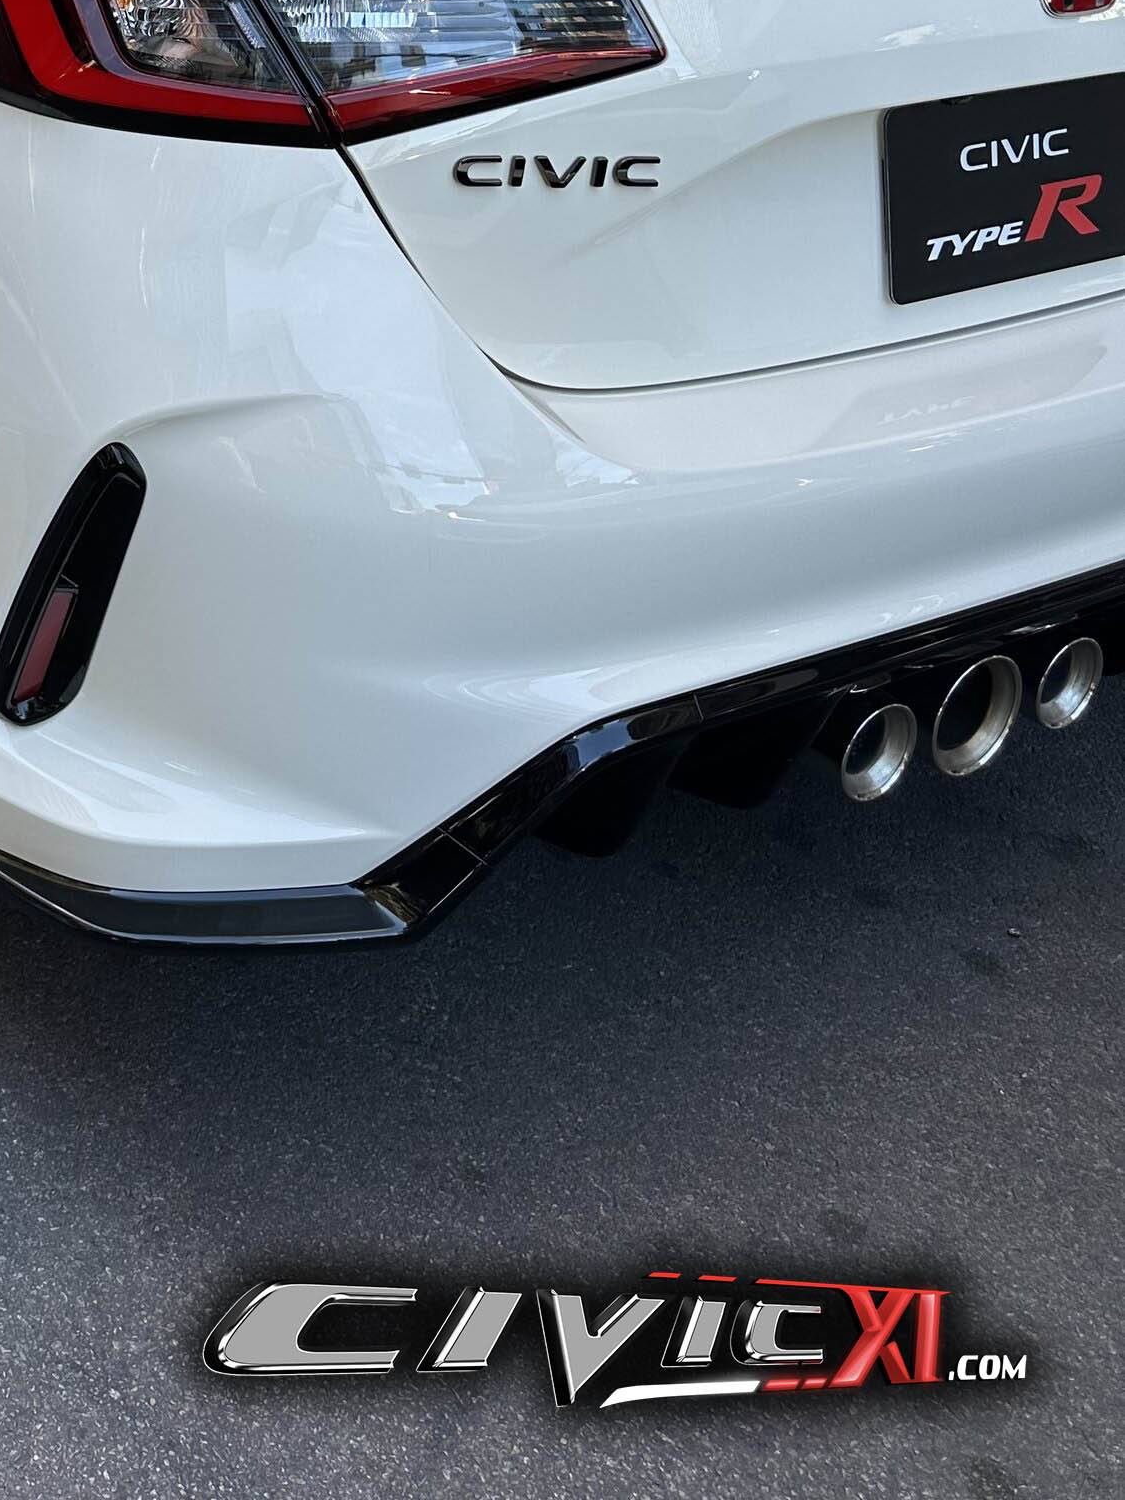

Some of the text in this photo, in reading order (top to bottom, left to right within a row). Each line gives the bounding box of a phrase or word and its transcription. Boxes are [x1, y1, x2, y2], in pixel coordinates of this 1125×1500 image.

[960, 128, 1069, 171] CIVIC
[453, 154, 661, 189] CIVIC
[926, 174, 1103, 262] TYPE R
